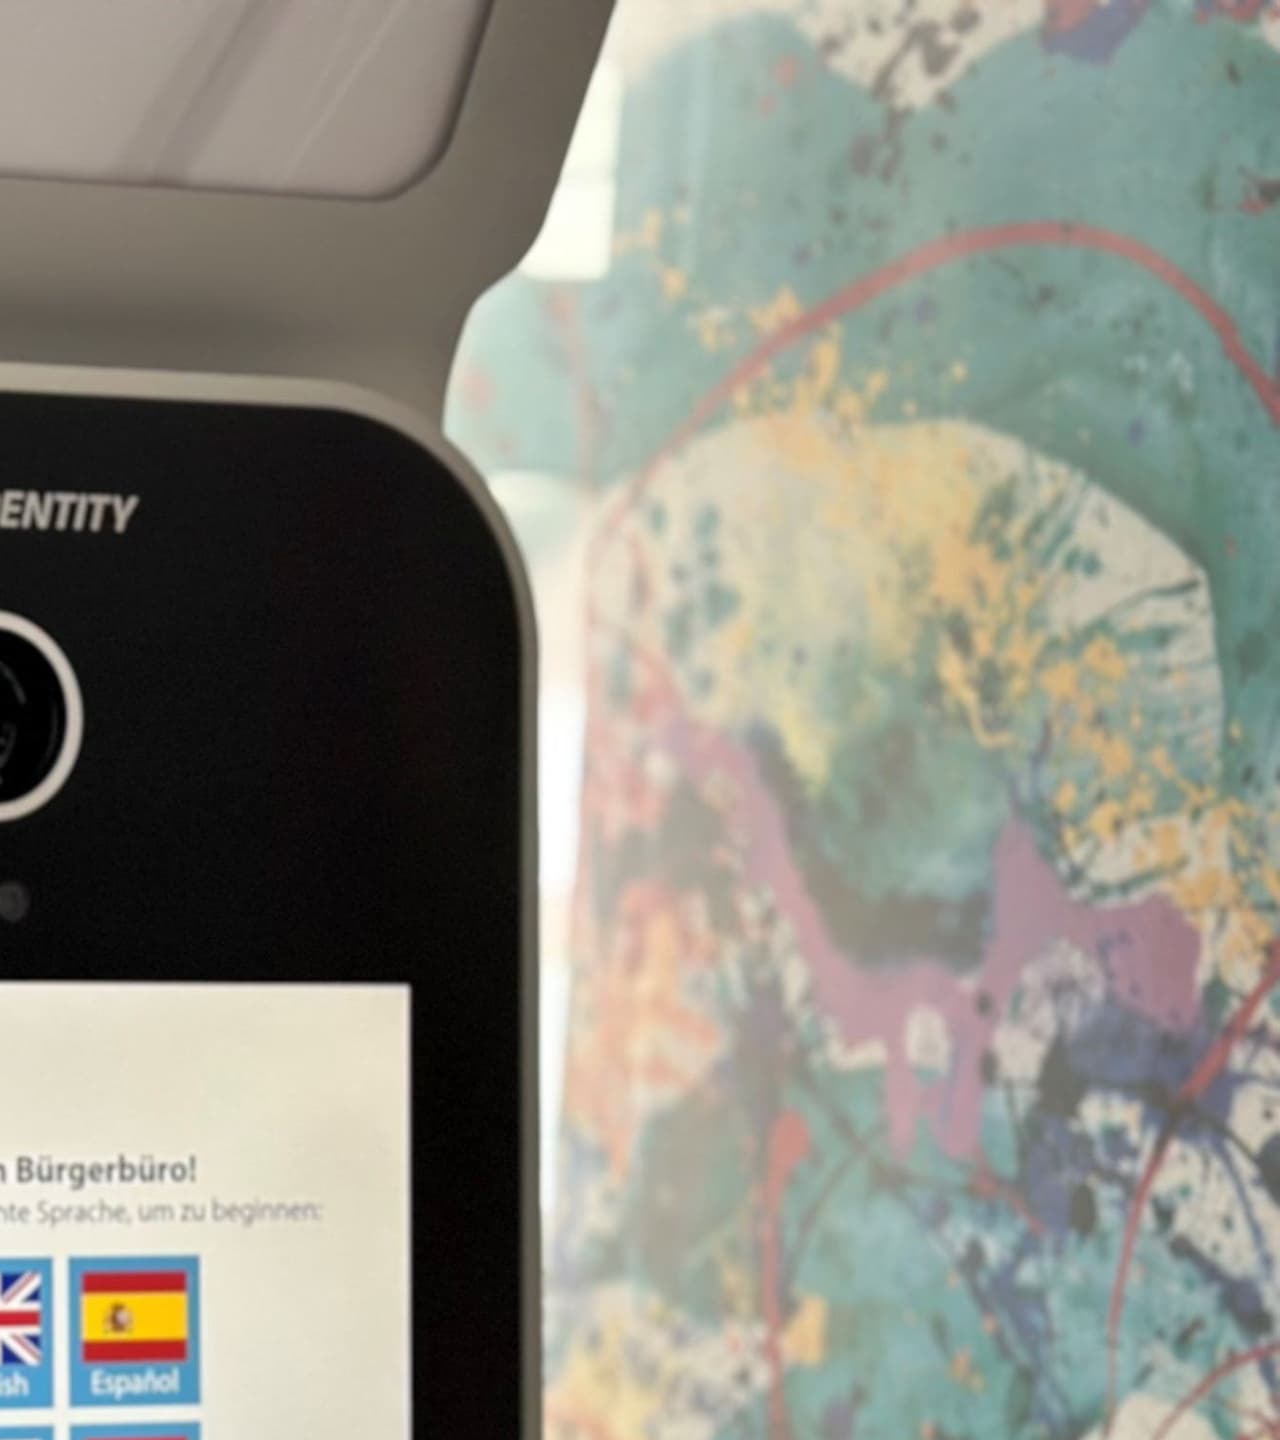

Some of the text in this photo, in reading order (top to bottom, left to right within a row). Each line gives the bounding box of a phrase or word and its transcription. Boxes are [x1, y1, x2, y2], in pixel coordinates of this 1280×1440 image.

[16, 1154, 197, 1190] Bürgerbüro!
[37, 1198, 132, 1229] Sprache,
[139, 1204, 175, 1223] um
[180, 1204, 205, 1222] zu
[91, 1368, 180, 1398] Español
